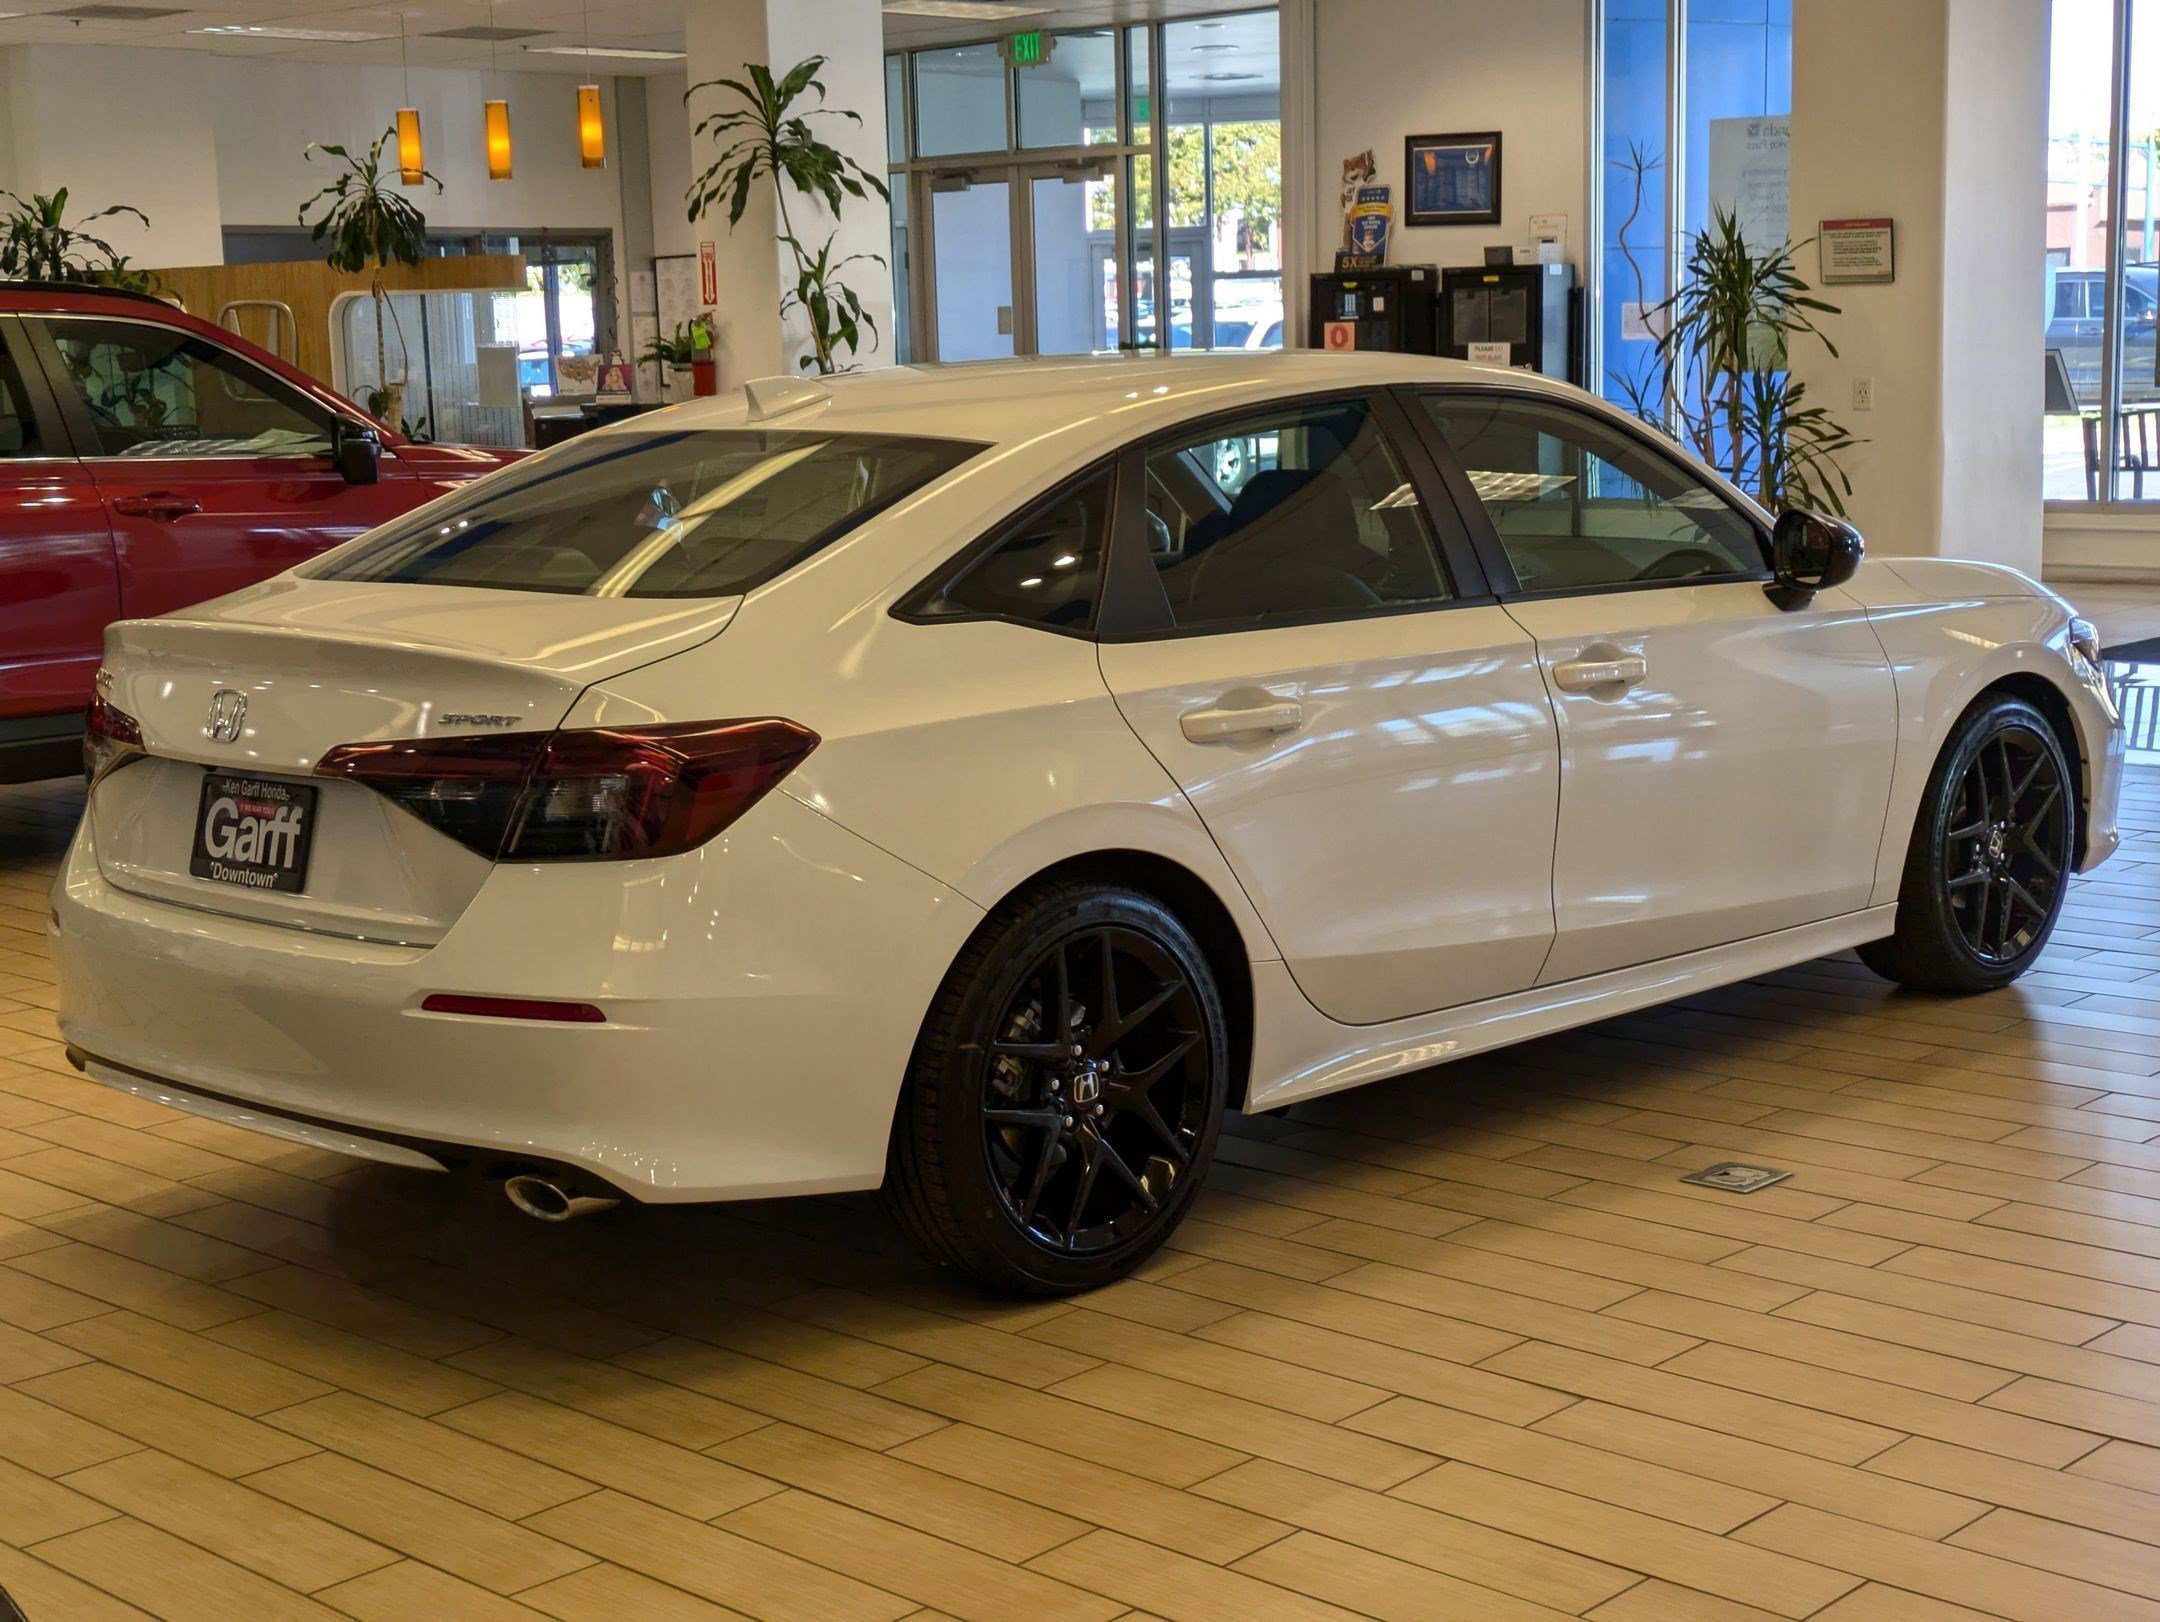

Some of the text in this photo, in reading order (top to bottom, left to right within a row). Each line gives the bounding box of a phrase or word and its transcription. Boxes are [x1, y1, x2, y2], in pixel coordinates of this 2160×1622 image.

[1014, 32, 1040, 61] EXIT
[438, 714, 523, 727] SPORT
[225, 778, 287, 801] Ken Garff Honda
[205, 797, 303, 868] Garff
